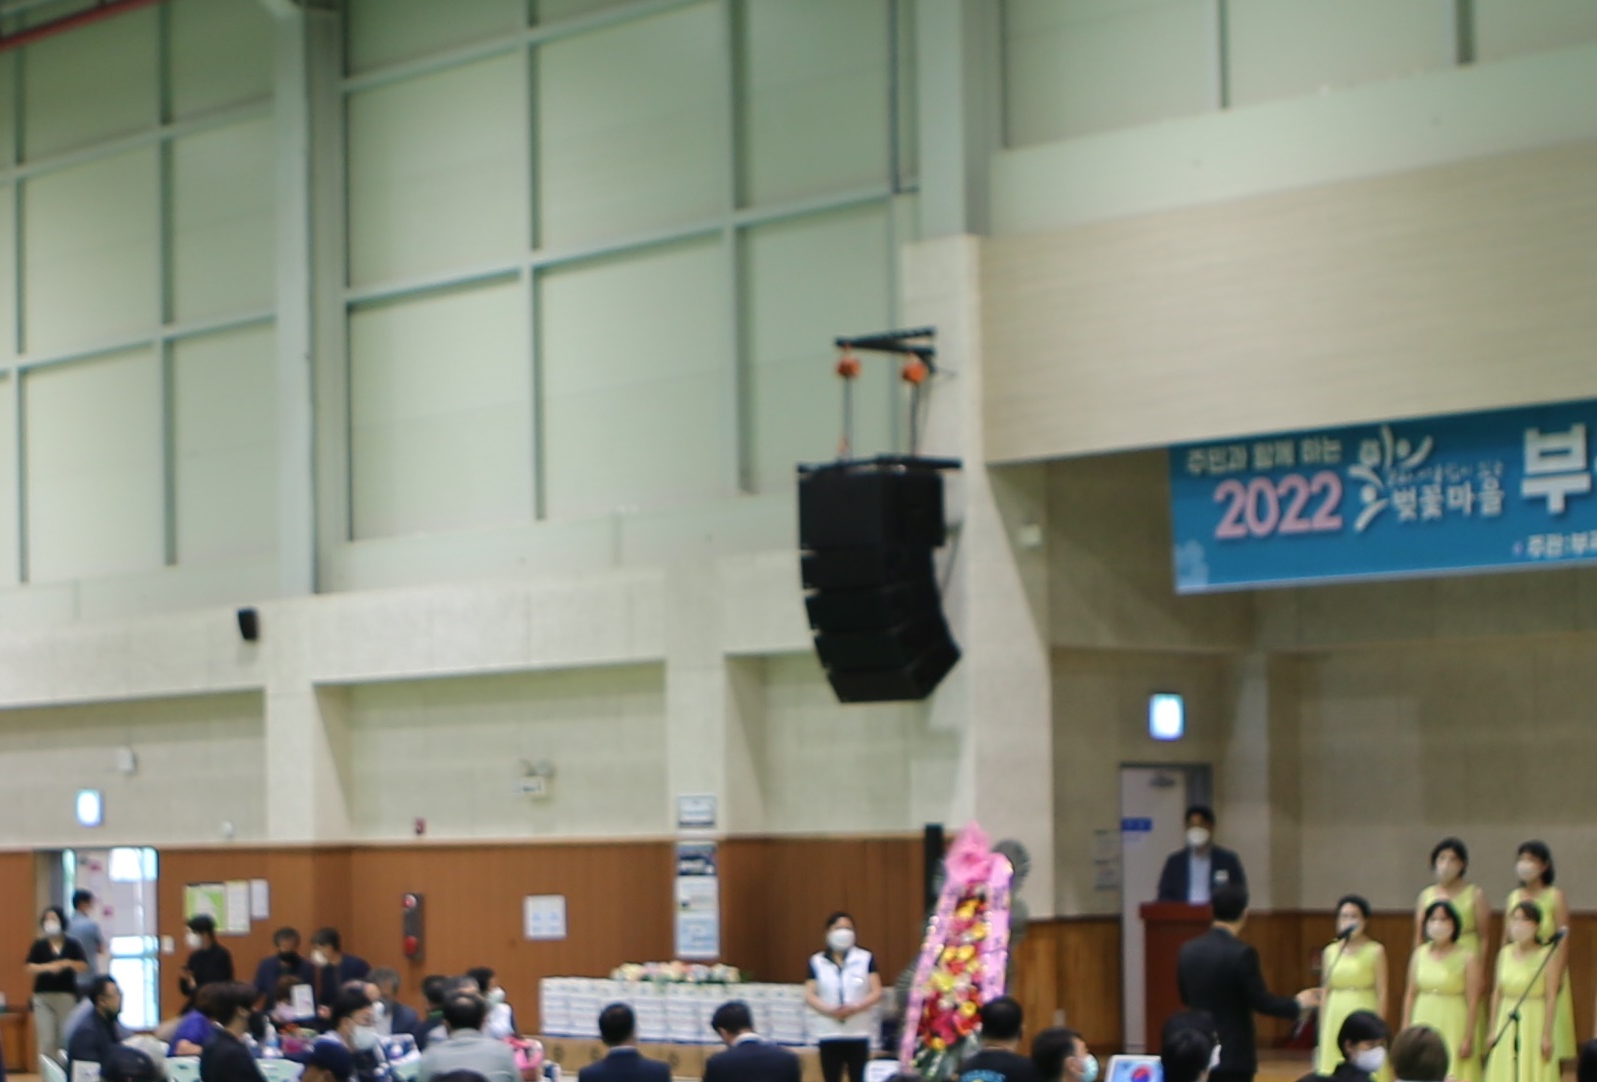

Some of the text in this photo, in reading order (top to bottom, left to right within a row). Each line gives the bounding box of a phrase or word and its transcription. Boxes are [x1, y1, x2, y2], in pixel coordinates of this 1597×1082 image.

[1187, 444, 1248, 475] 주민과
[1300, 436, 1343, 464] 하는
[1213, 470, 1344, 539] 2022
[1391, 476, 1505, 521] 벚꽃마을
